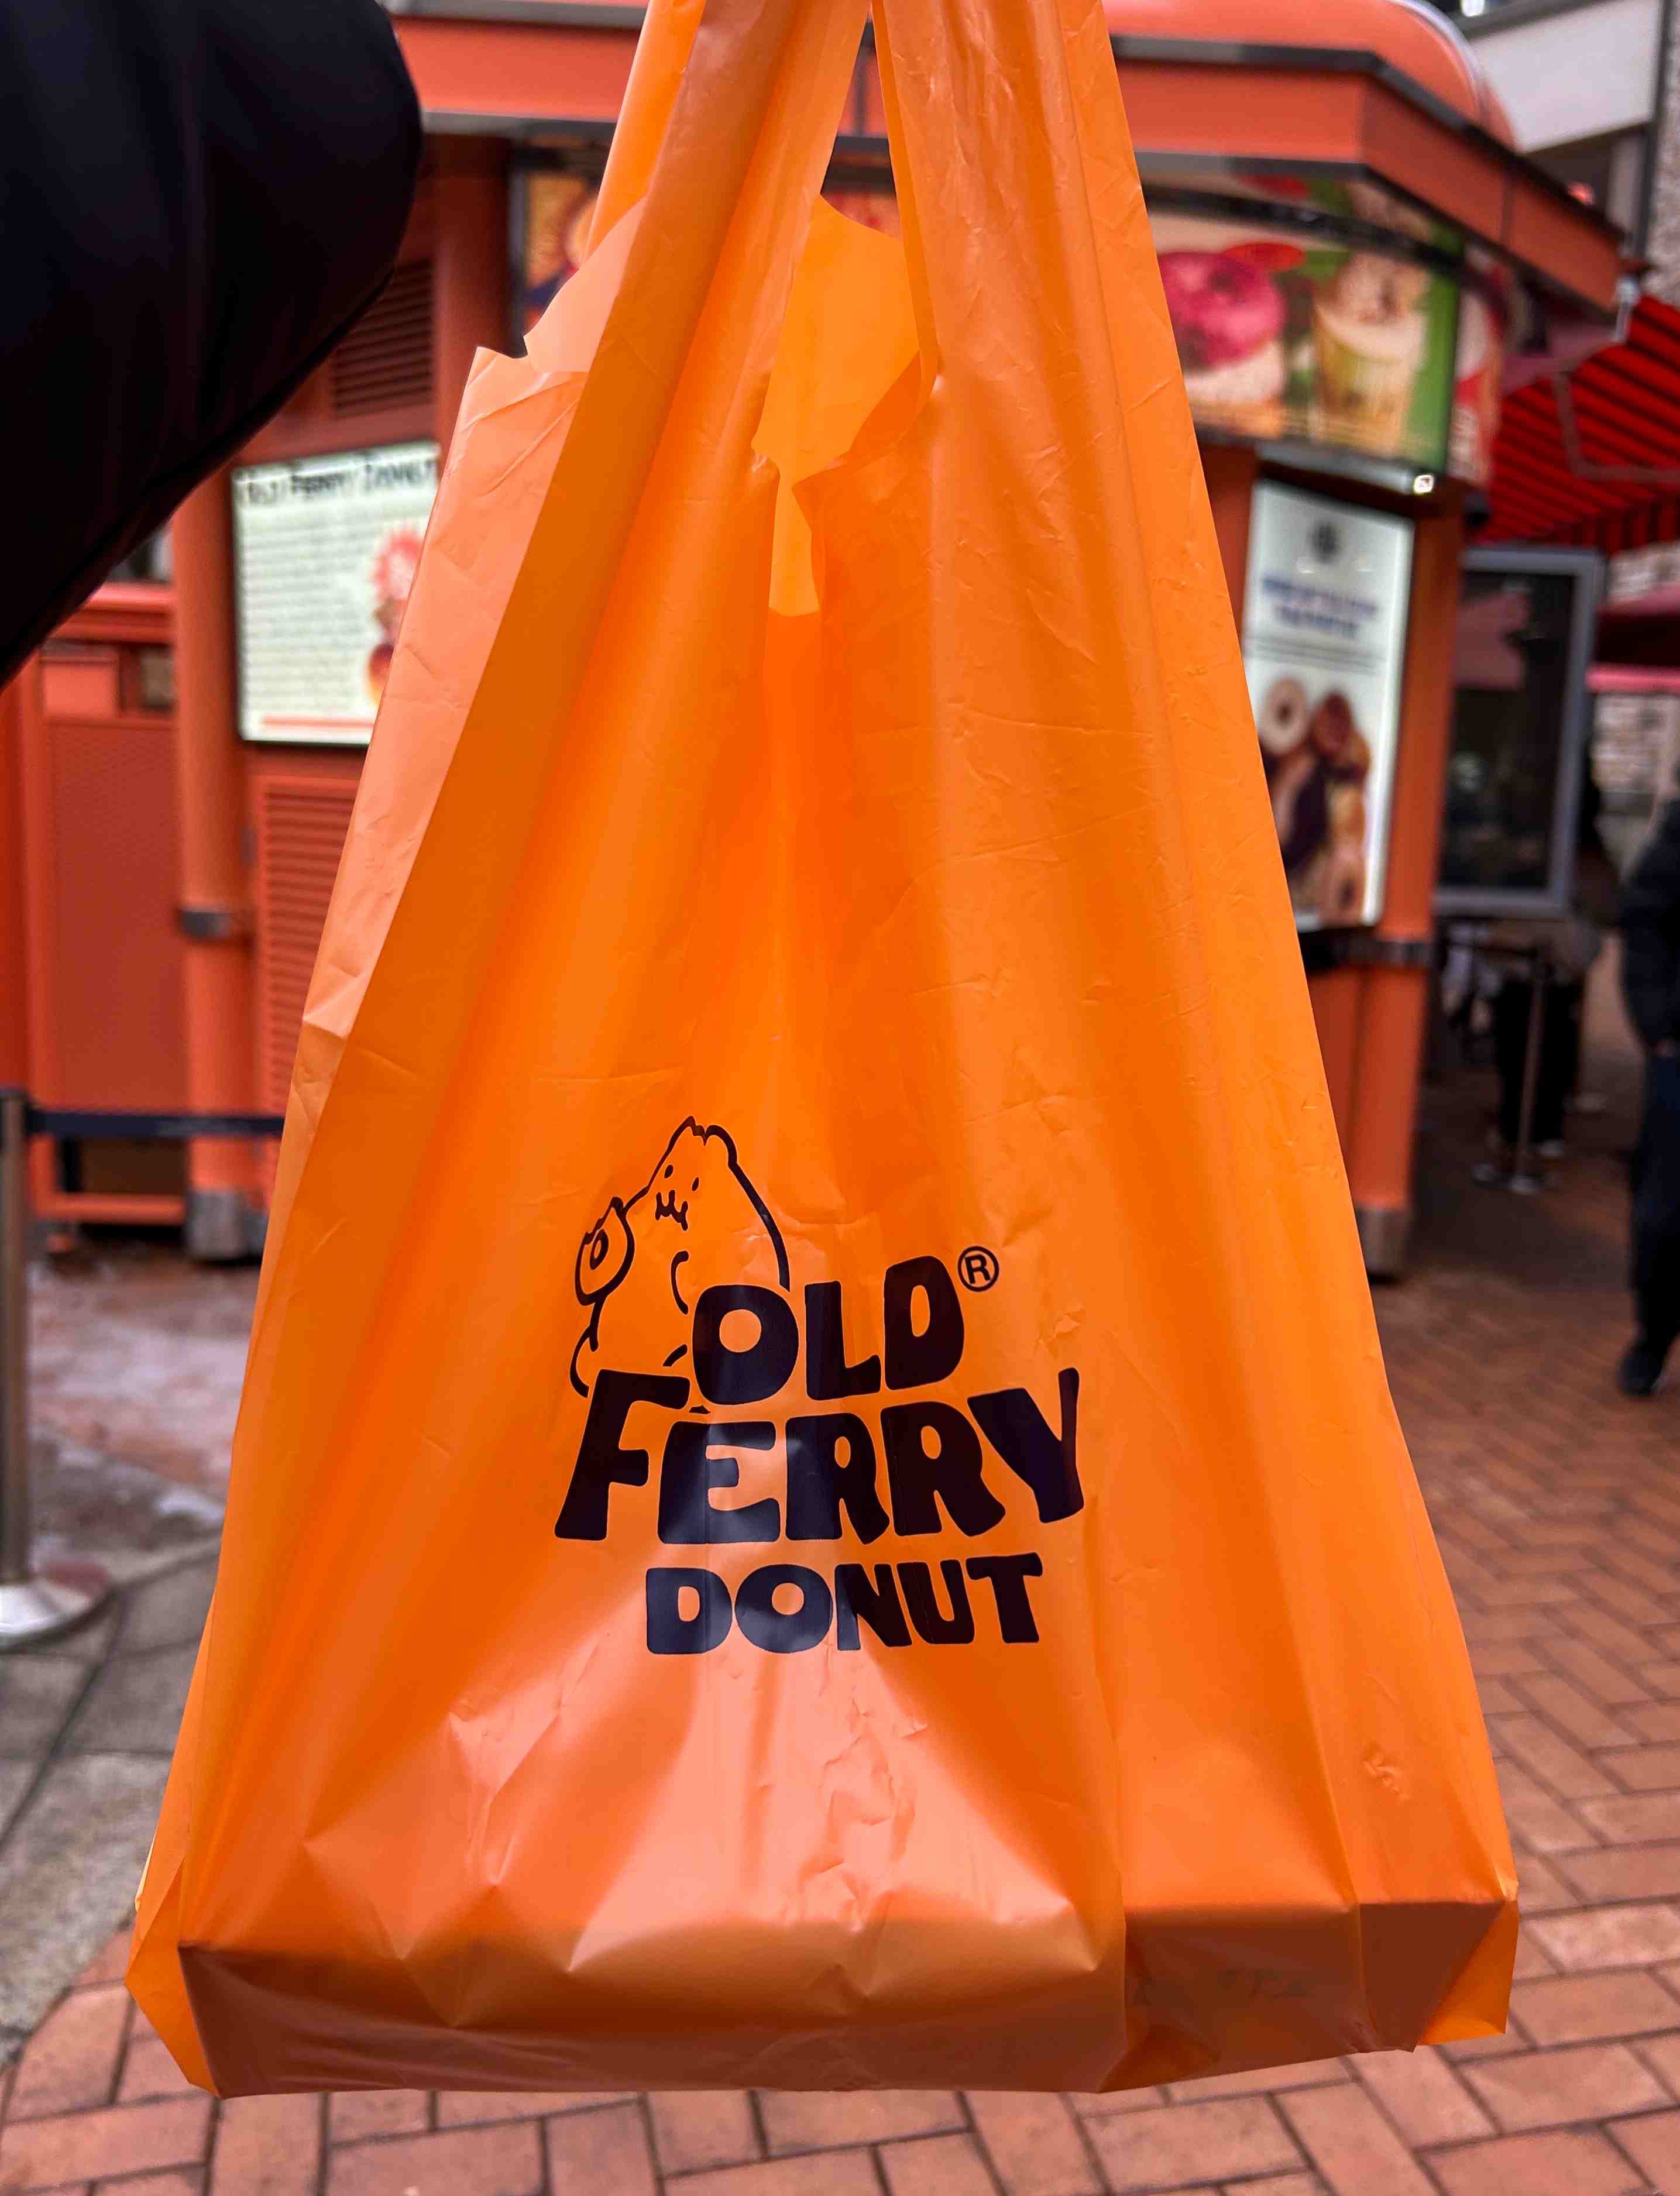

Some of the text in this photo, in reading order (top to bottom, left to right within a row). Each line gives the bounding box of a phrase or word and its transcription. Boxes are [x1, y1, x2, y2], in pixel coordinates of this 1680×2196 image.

[693, 1256, 964, 1405] OLD
[554, 1367, 1084, 1544] FERRY
[645, 1553, 1043, 1655] DONUT
